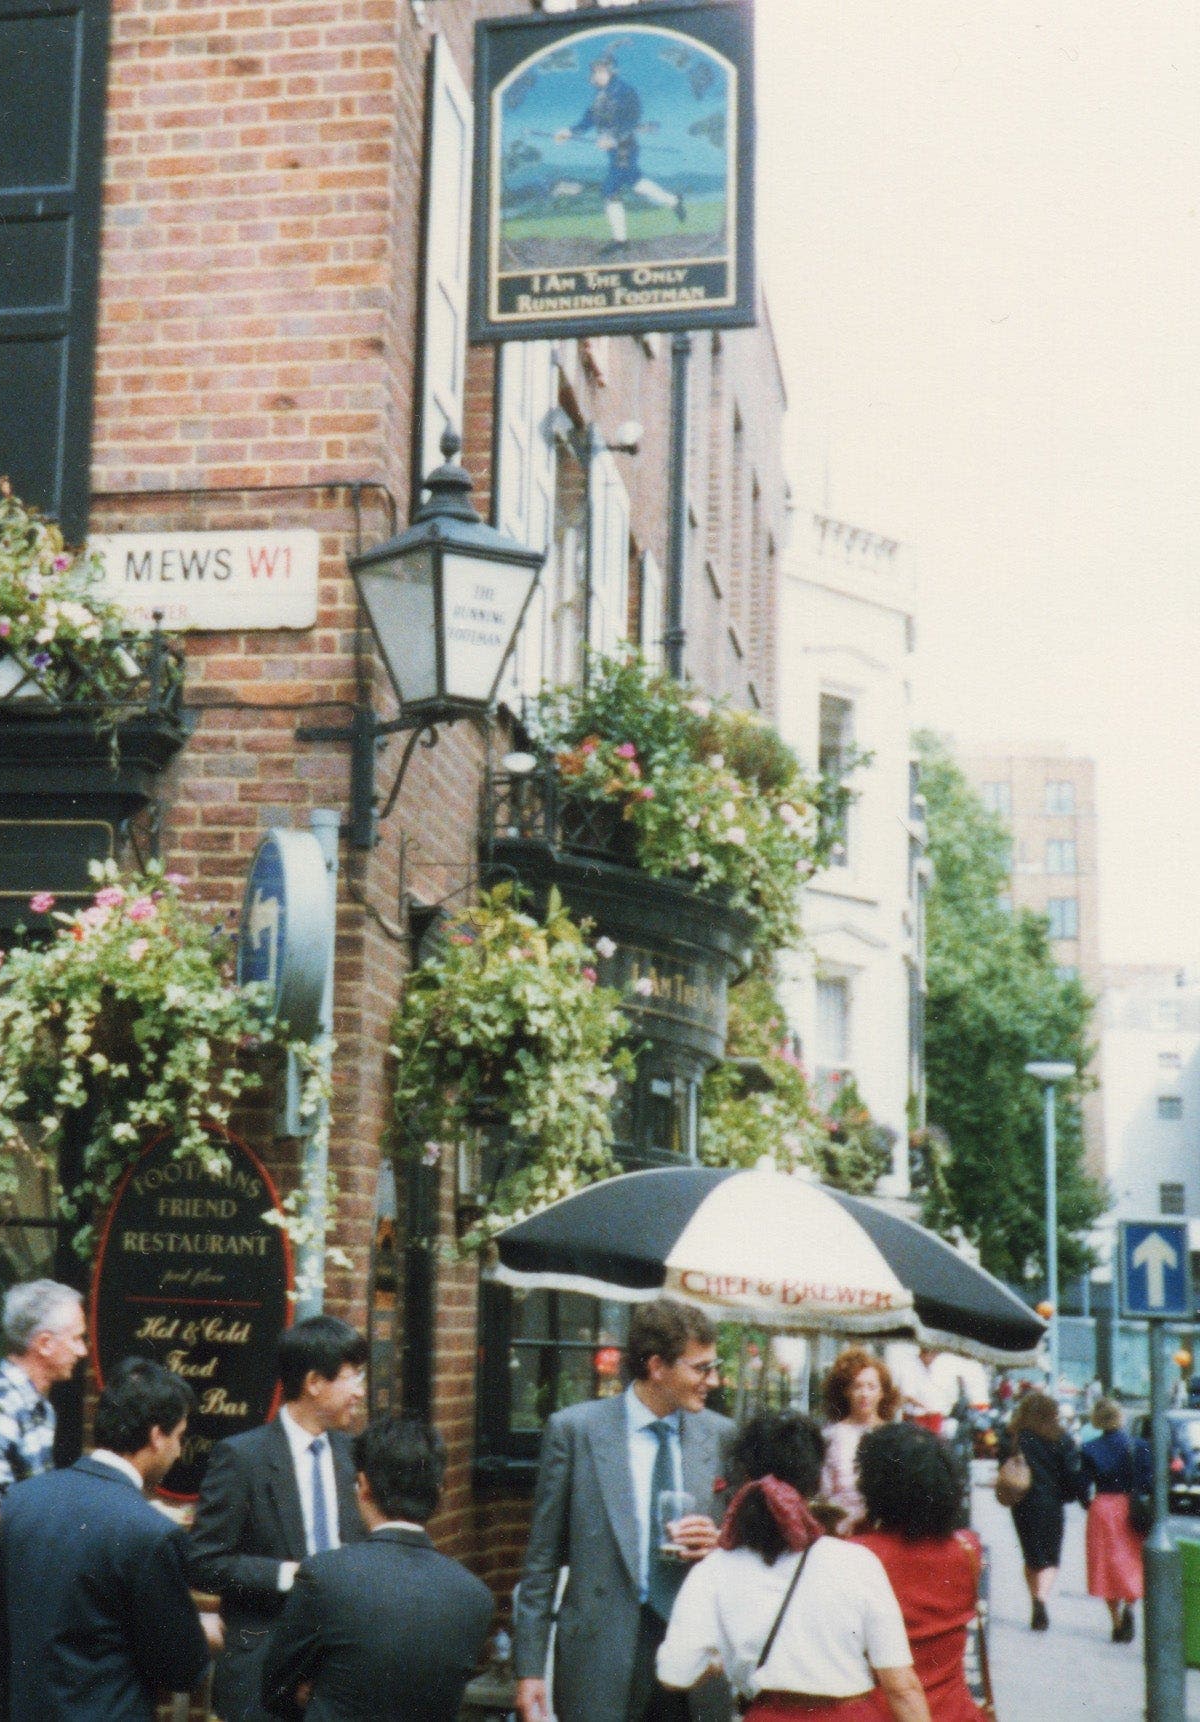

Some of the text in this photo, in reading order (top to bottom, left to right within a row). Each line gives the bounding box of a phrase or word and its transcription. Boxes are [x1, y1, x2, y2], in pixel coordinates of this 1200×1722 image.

[532, 268, 688, 293] I AM THE ONLY
[516, 286, 705, 312] RUNNING FOOTMAN
[126, 549, 232, 582] MEWS
[248, 546, 292, 579] W1
[158, 1198, 238, 1219] FRIEND
[122, 1231, 270, 1256] RESTAURANT
[680, 1270, 748, 1296] CHEF
[781, 1279, 892, 1310] BREWER
[135, 1316, 251, 1346] Hot & Cold
[168, 1349, 219, 1378] Food
[199, 1388, 249, 1416] Bar
